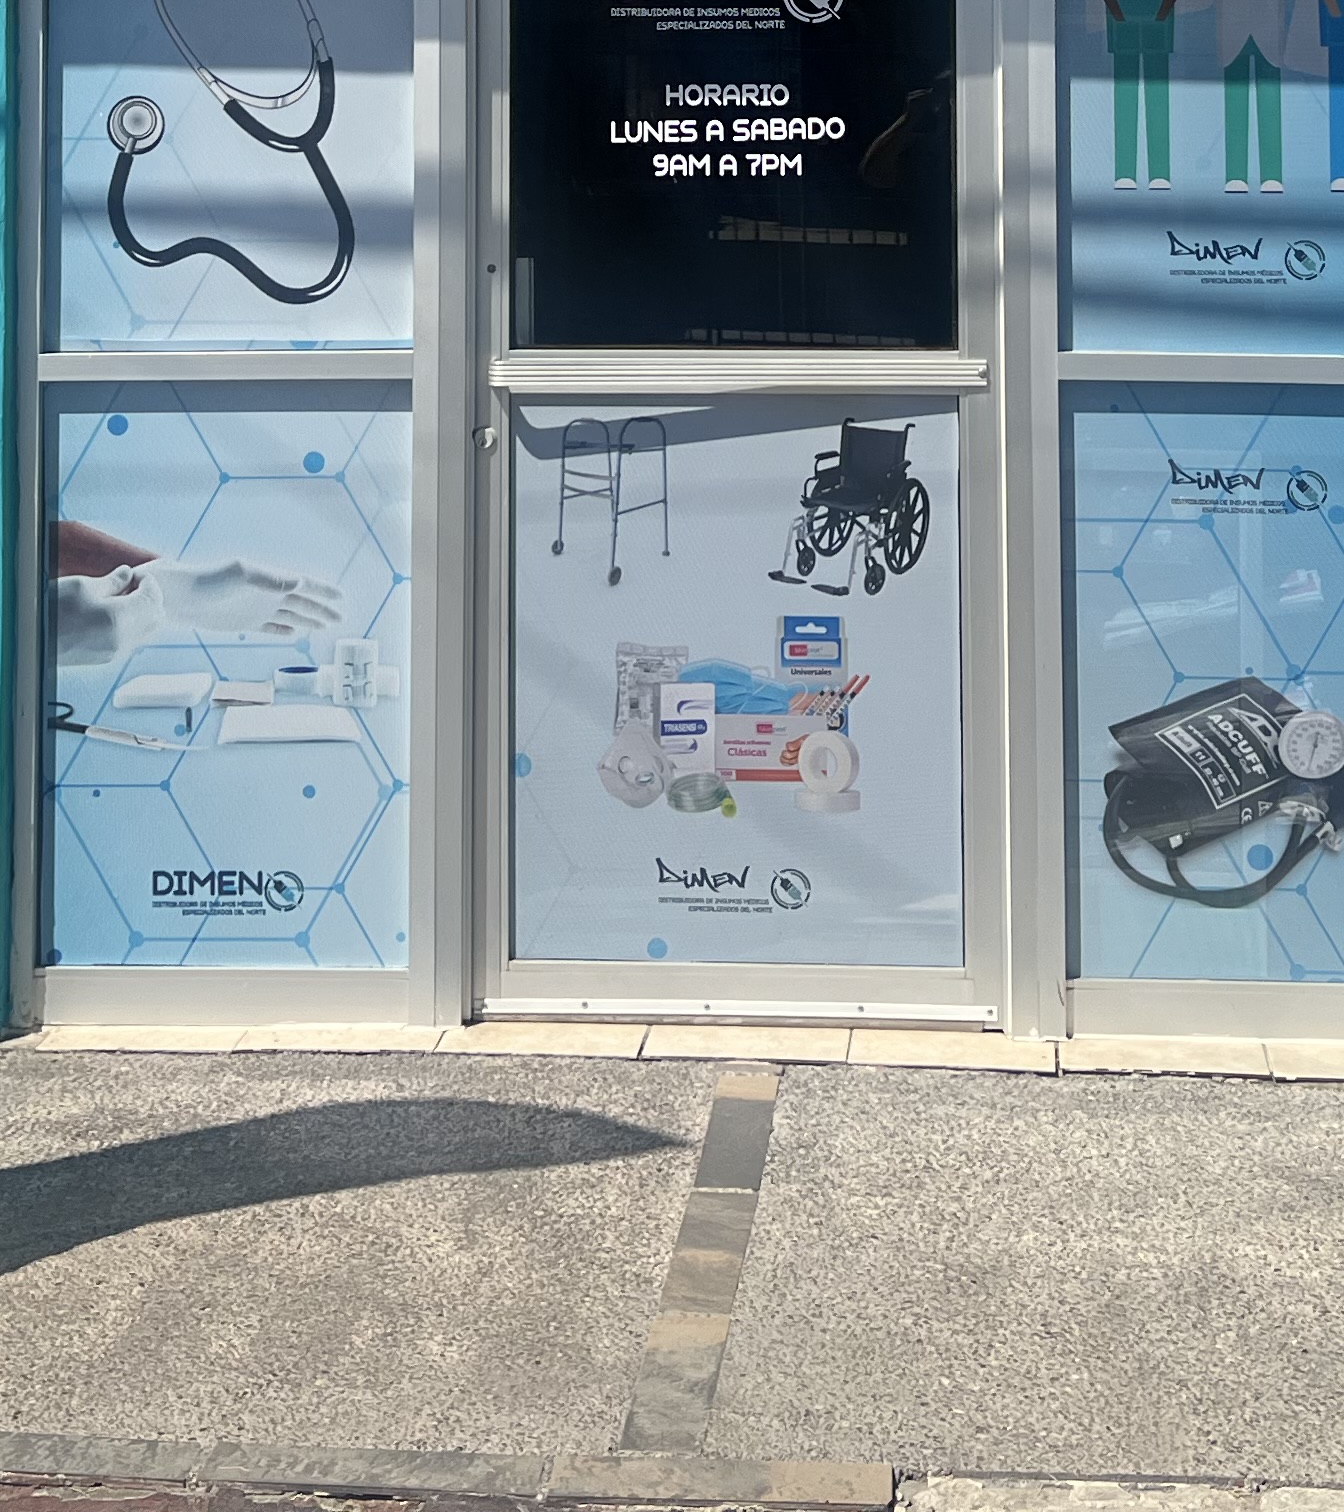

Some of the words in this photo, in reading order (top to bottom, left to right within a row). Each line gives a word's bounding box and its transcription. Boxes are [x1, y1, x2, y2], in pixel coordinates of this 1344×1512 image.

[610, 7, 682, 18] DISTRIBUIDORA
[683, 7, 695, 17] DE
[696, 7, 740, 17] INSUMOS
[656, 20, 735, 31] ESPECIALIZADOS
[735, 20, 754, 30] DEL
[754, 19, 786, 30] NORTE
[665, 83, 790, 107] HORARIO
[610, 119, 698, 144] LUNES
[705, 119, 725, 142] A
[732, 116, 846, 142] SABADO
[653, 153, 711, 177] 9AM
[718, 153, 738, 177] A
[745, 153, 803, 177] 7PM
[152, 870, 263, 896] DIMEN
